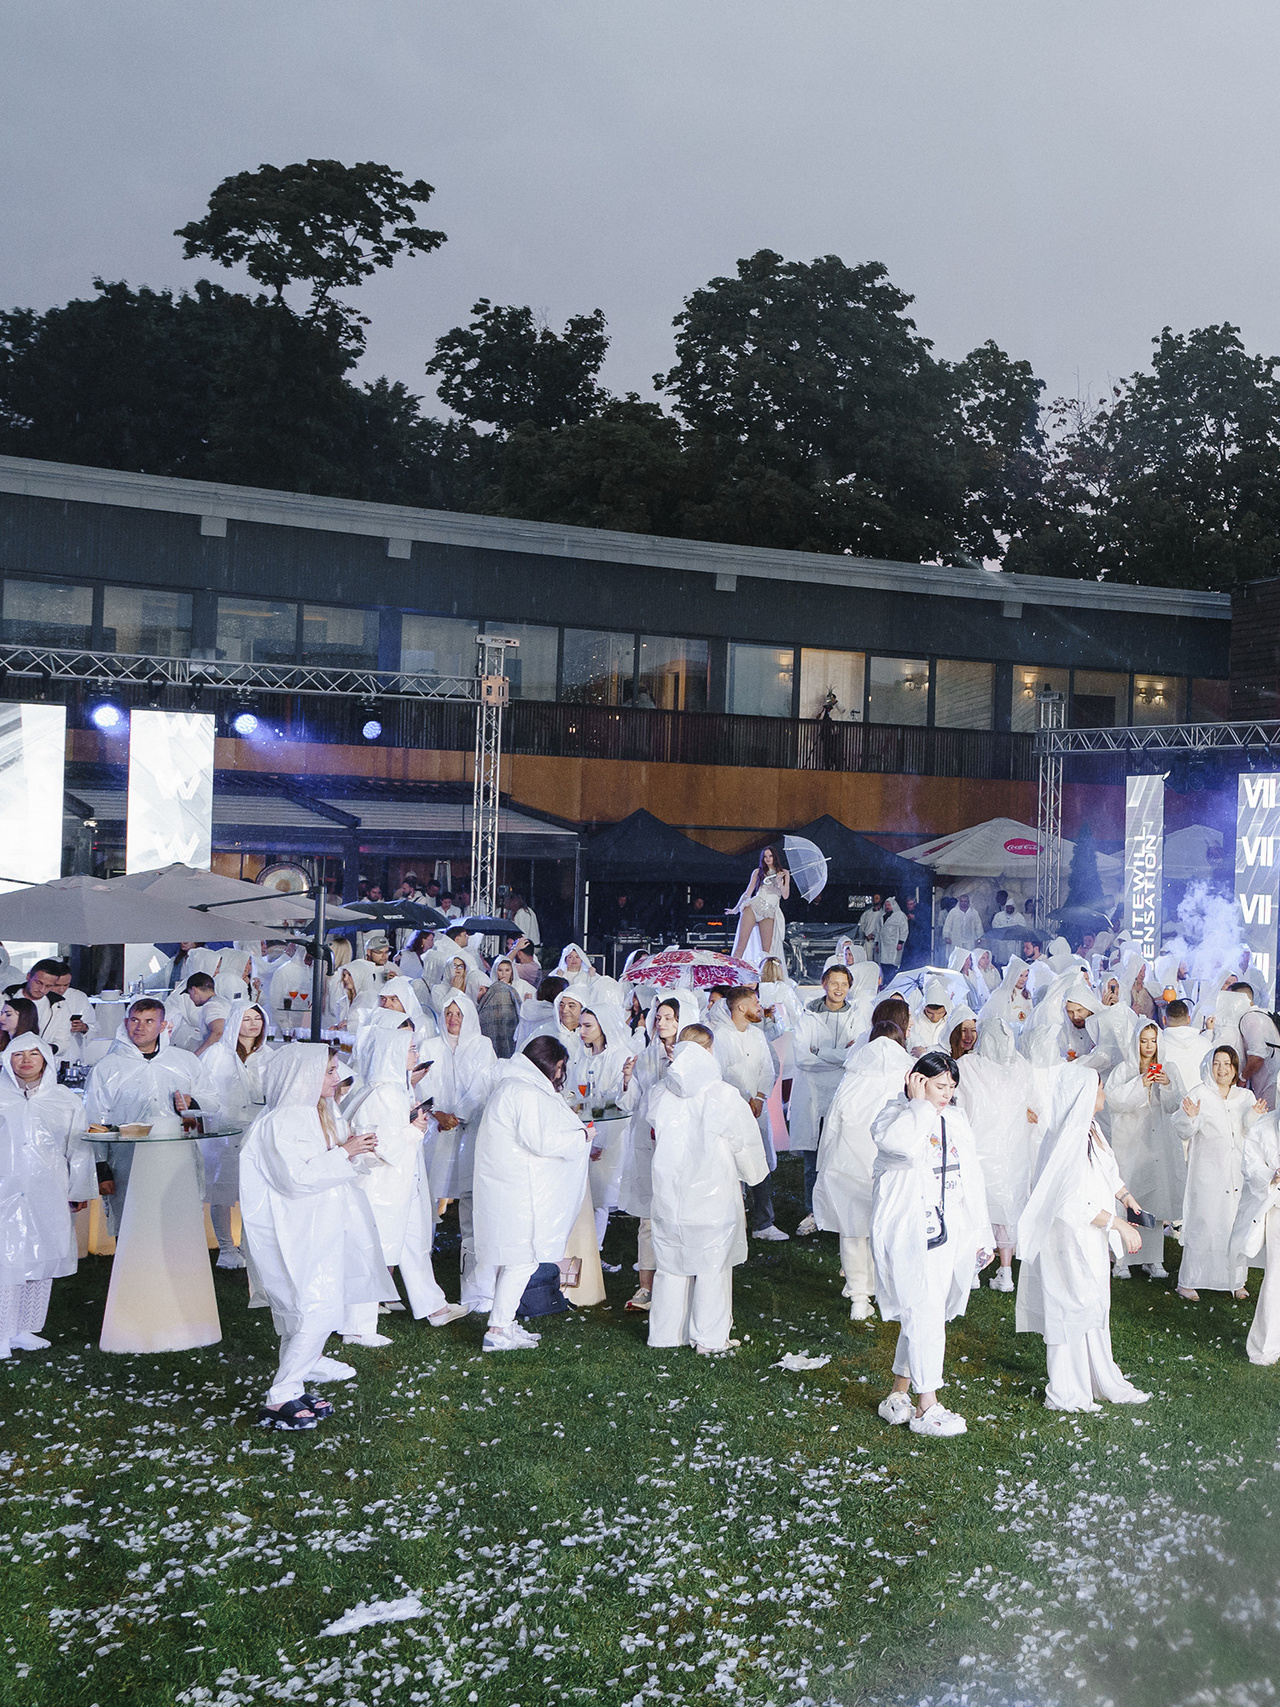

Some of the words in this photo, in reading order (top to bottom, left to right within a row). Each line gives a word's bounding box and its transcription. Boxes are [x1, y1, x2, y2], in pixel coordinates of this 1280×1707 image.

[1244, 778, 1276, 808] VII
[1242, 836, 1274, 866] VII
[1239, 893, 1272, 925] VII
[1250, 952, 1270, 983] II
